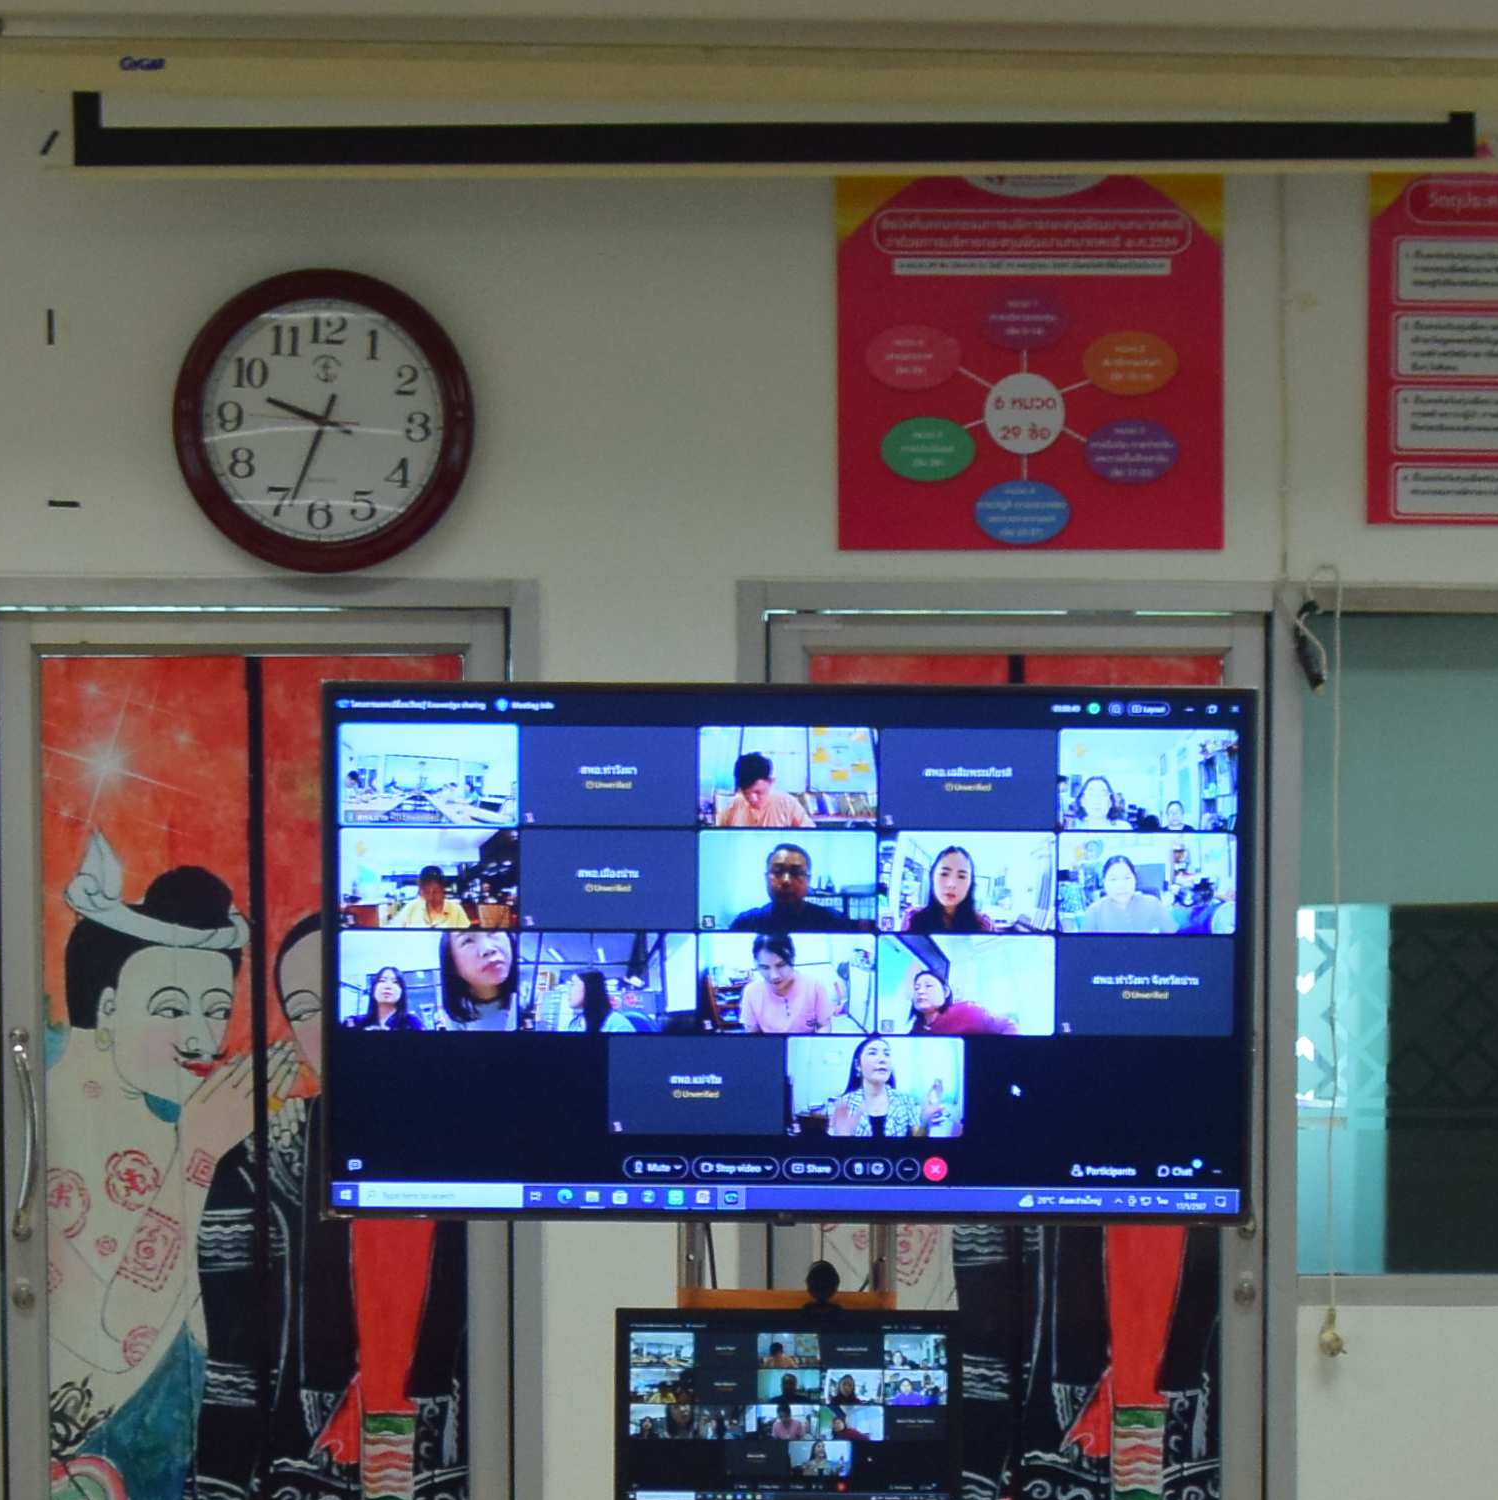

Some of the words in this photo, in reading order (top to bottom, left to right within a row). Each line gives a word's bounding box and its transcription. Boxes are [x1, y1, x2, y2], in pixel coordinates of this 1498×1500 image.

[270, 324, 301, 357] 11
[310, 316, 348, 345] 12
[366, 329, 380, 361] 1
[233, 356, 270, 389] 10
[395, 364, 419, 397] 2
[217, 400, 244, 432] 9
[995, 396, 1006, 411] 6
[405, 411, 432, 443] 3
[229, 447, 256, 479] 8
[384, 457, 411, 489] 4
[267, 486, 293, 517] 7
[307, 498, 333, 530] 6
[350, 490, 377, 522] 5
[647, 1163, 672, 1173] Mute
[715, 1164, 736, 1175] Stop
[737, 1163, 762, 1173] video
[806, 1164, 832, 1174] Share
[1085, 1166, 1137, 1178] Participants
[1171, 1167, 1194, 1177] Chat
